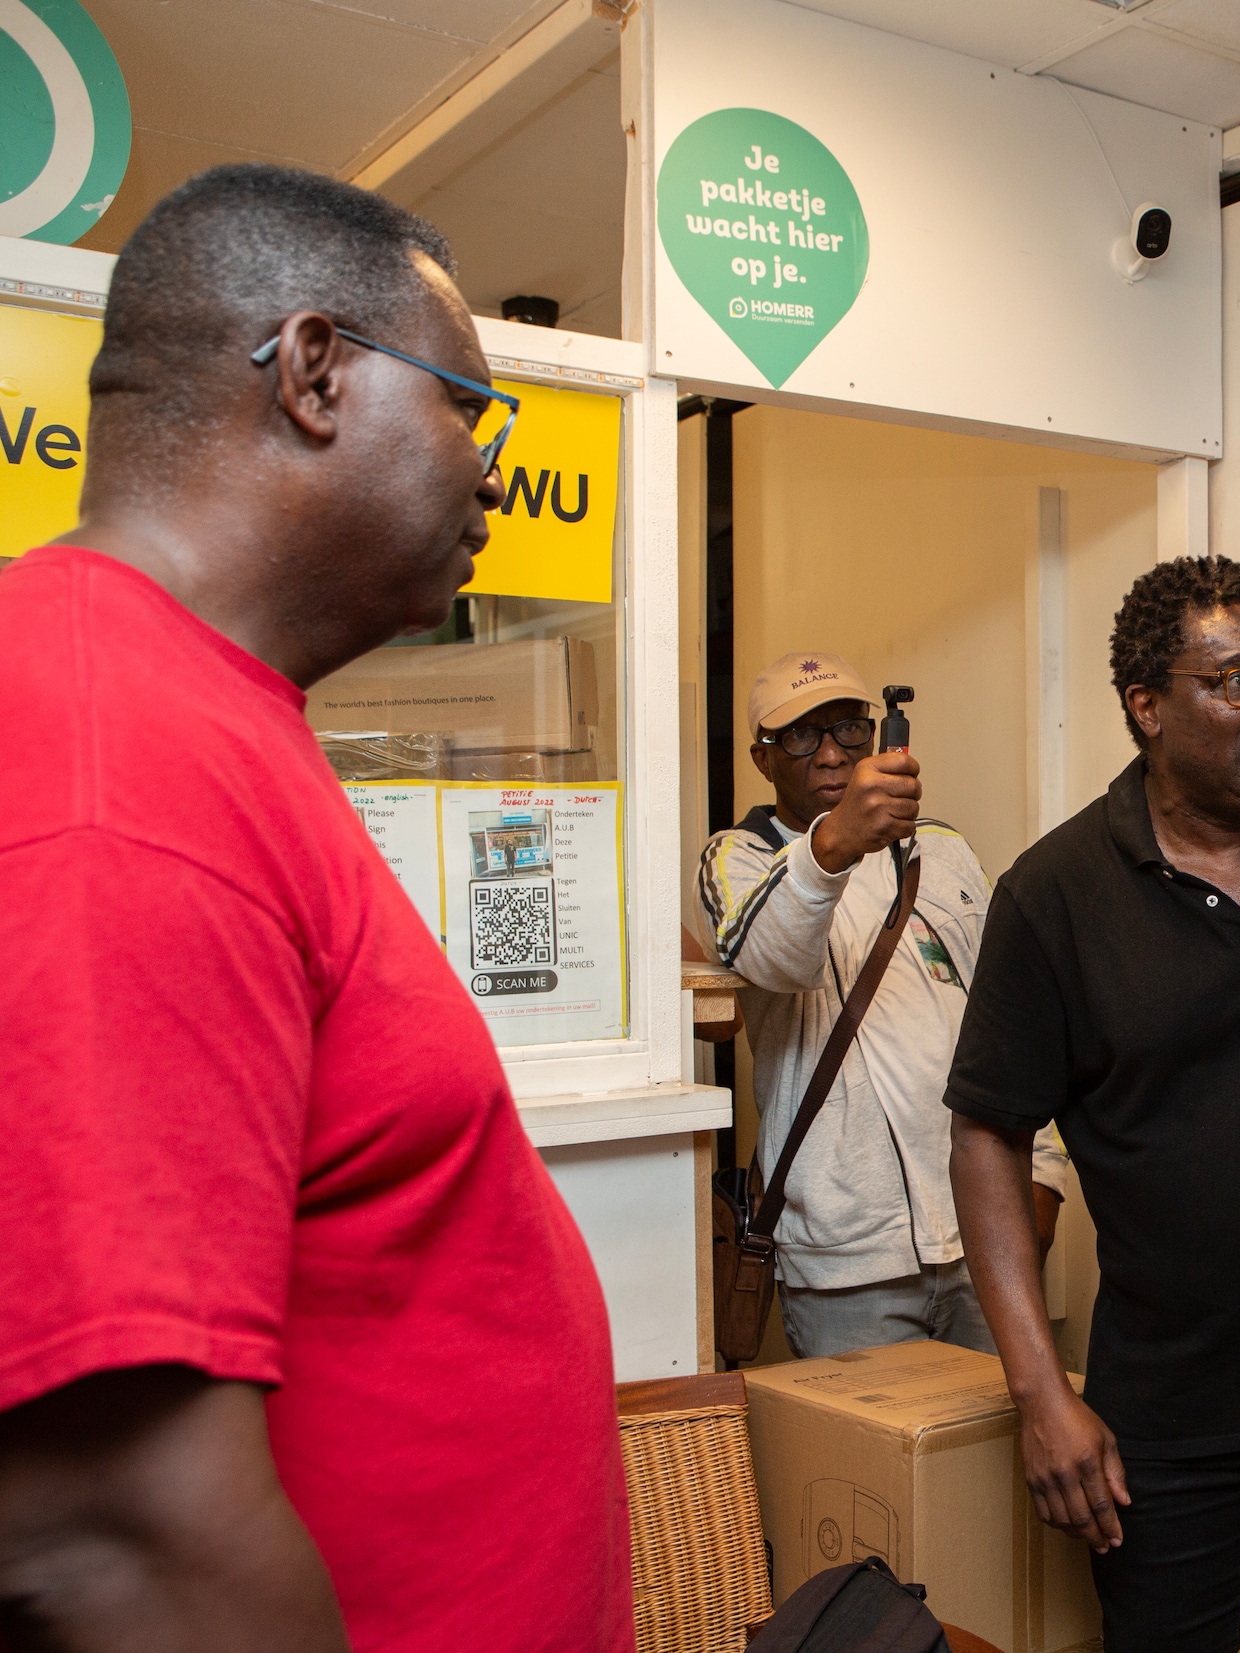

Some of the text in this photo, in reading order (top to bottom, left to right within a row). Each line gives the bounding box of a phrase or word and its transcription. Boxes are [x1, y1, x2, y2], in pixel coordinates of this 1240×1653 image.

[744, 145, 780, 174] Je
[700, 177, 826, 222] pakketje
[685, 214, 844, 253] wacht hier
[730, 254, 807, 289] op je.
[750, 299, 815, 319] HOMERR
[751, 313, 815, 327] Duurzaam verzenden
[790, 673, 840, 690] BALANCE
[324, 701, 338, 709] The
[339, 700, 366, 709] world's
[384, 698, 411, 706] fashion
[412, 697, 450, 706] boutiques
[474, 694, 497, 704] place.
[499, 798, 531, 806] AUGUST
[534, 798, 555, 806] 2022
[367, 809, 395, 818] Please
[554, 810, 594, 818] Onderteken
[368, 825, 386, 835] Sign
[554, 824, 575, 832] A.U.B
[554, 838, 572, 846] Deze
[555, 852, 578, 860] Petitie
[557, 904, 581, 912] Sluiten
[559, 931, 579, 940] UNIC
[560, 946, 584, 955] MULTI
[560, 960, 595, 969] SERVICES
[496, 976, 547, 990] SCAN ME
[525, 1005, 565, 1013] ondertekening
